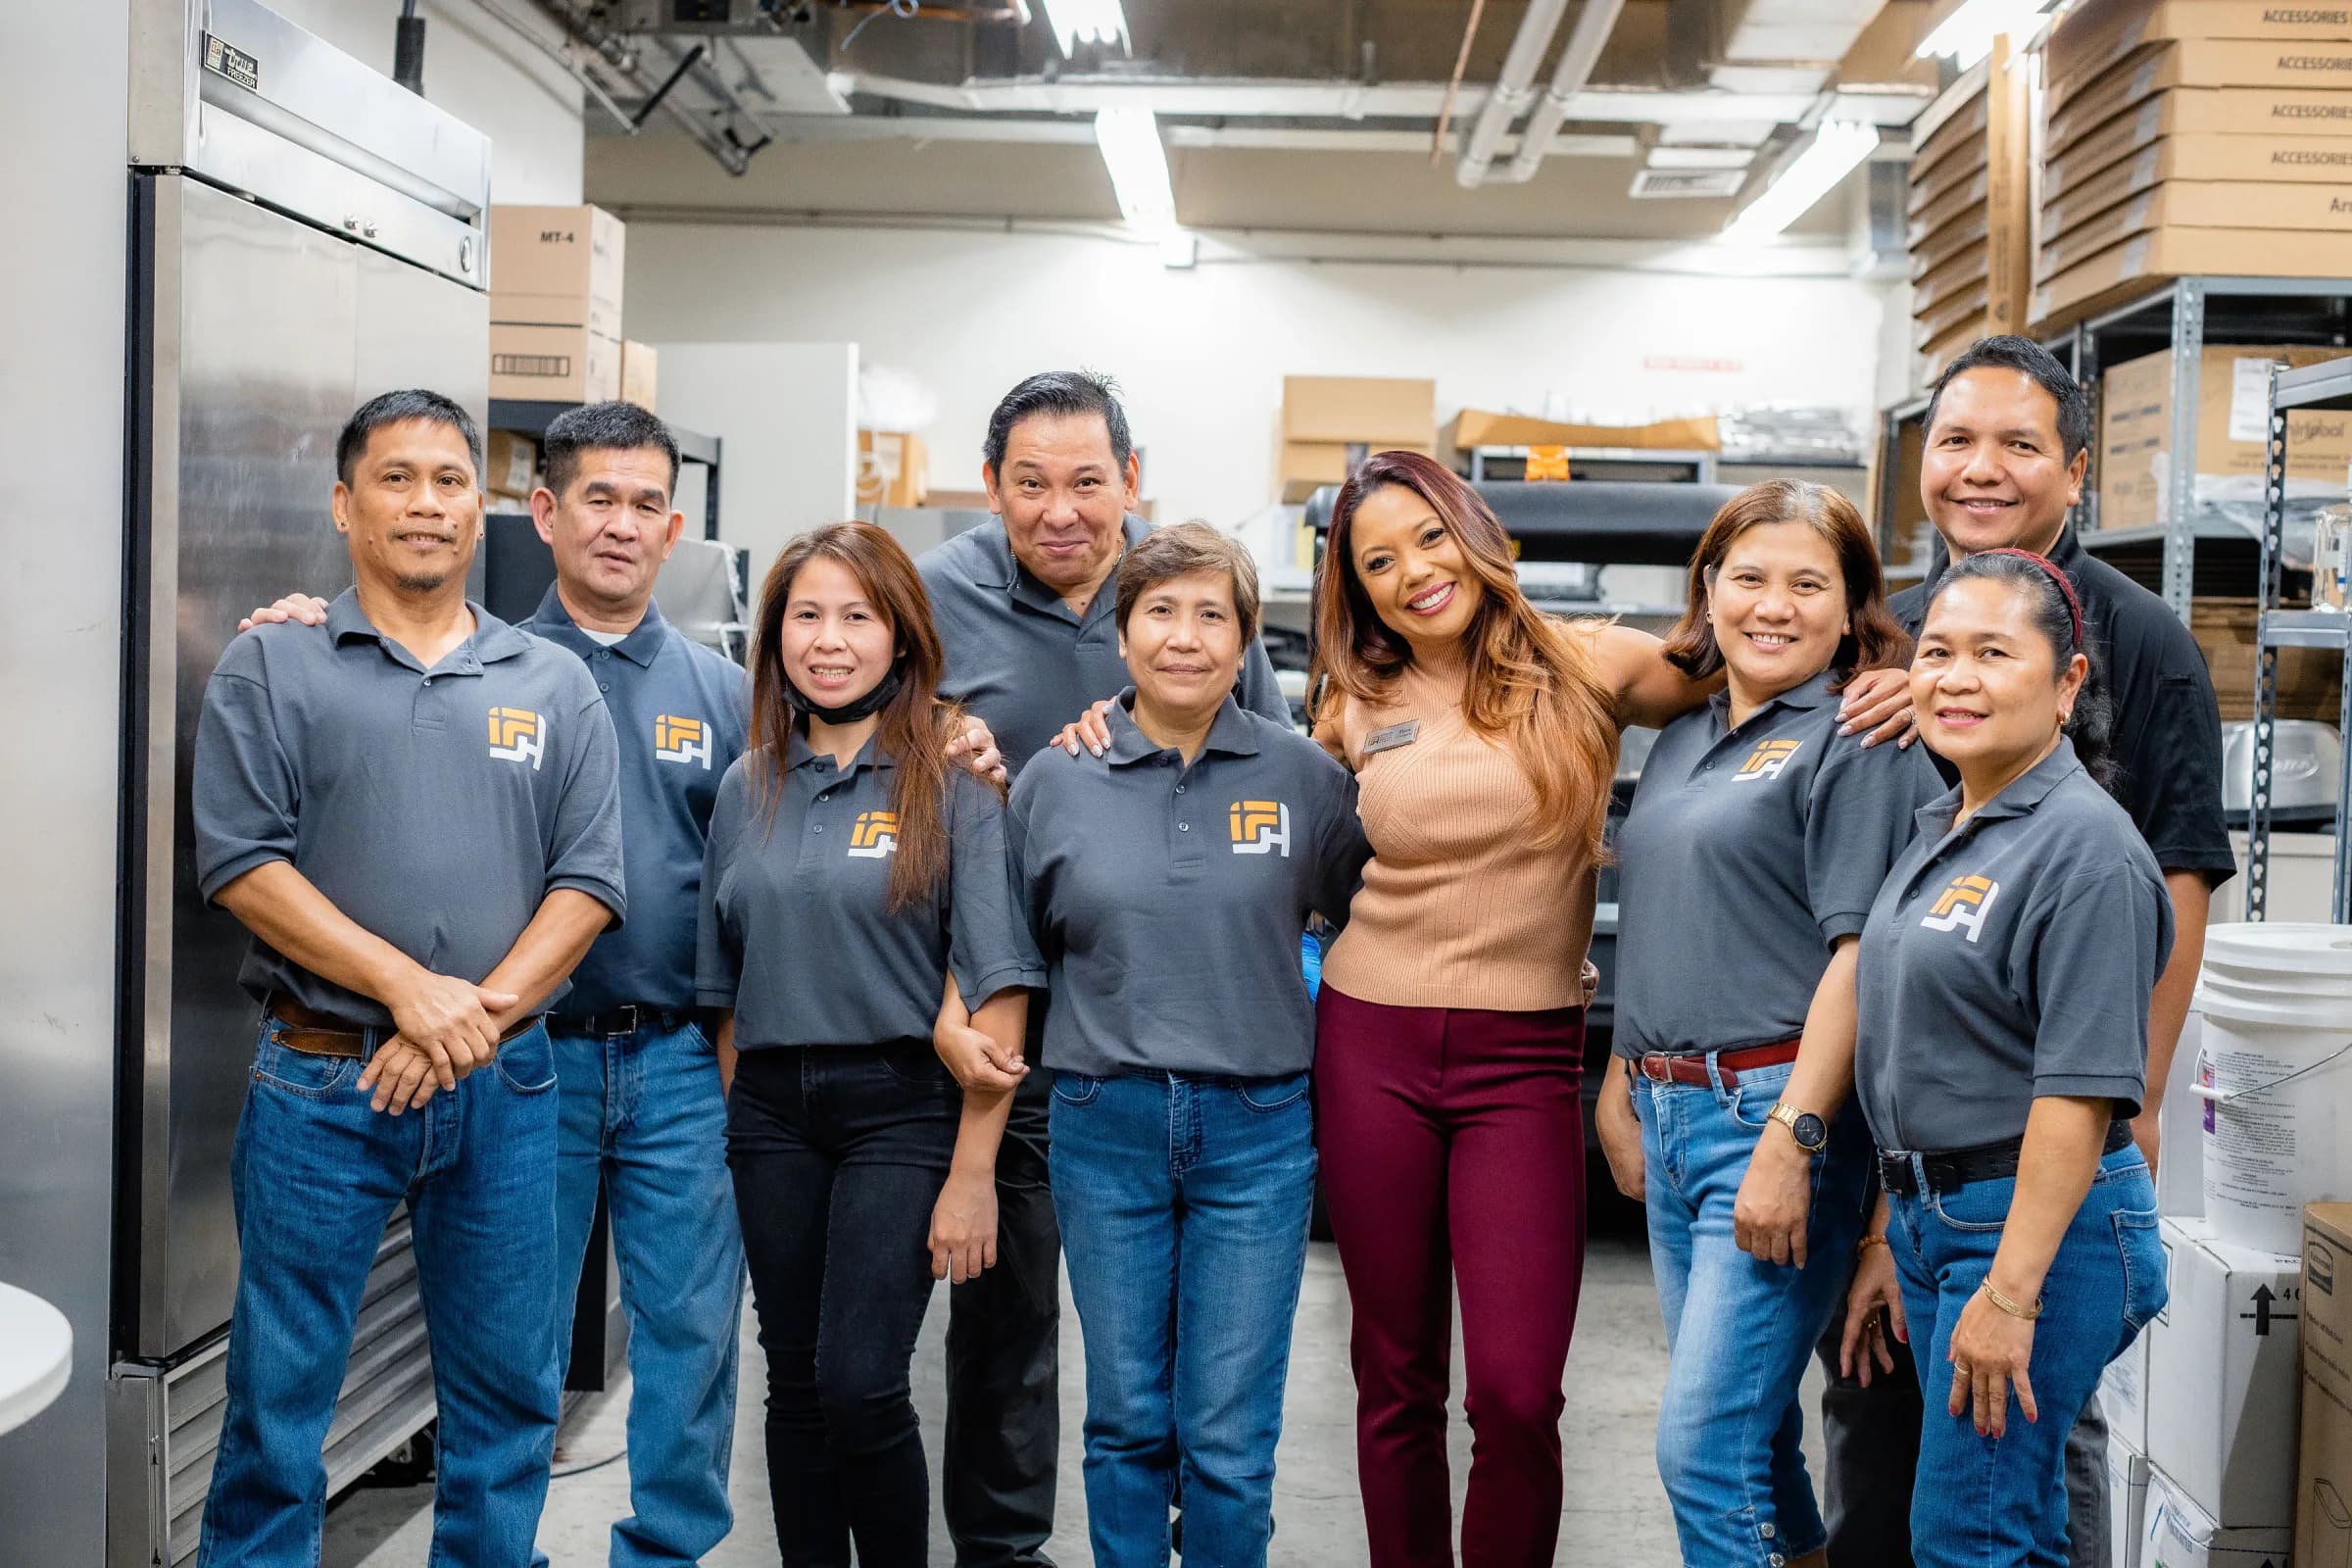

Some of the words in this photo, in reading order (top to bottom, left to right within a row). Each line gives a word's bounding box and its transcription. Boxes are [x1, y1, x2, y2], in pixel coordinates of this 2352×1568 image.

[2263, 10, 2348, 24] ACCESSORIES
[227, 68, 256, 88] FREEZER
[541, 231, 574, 243] MT-4
